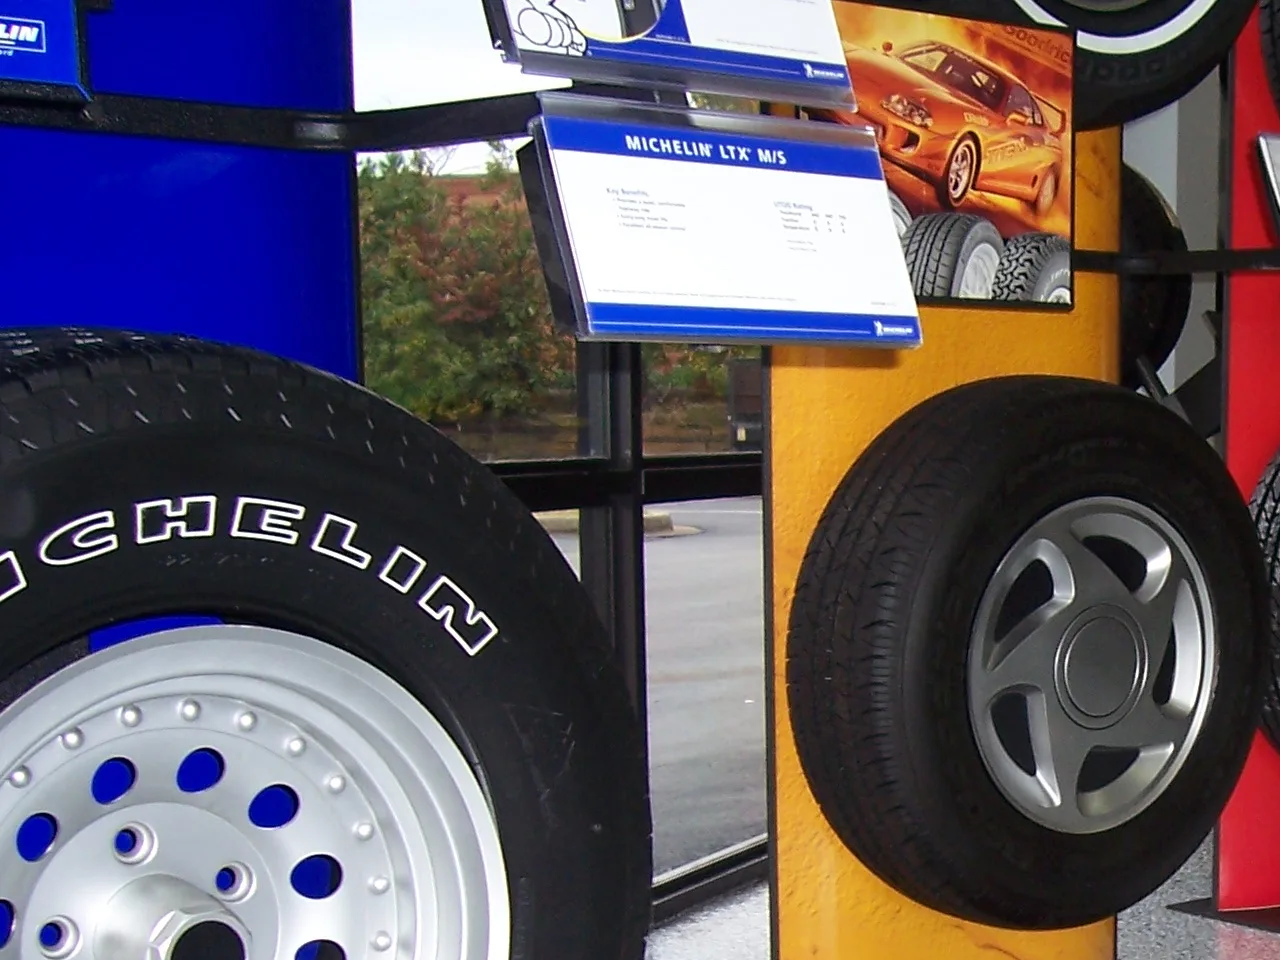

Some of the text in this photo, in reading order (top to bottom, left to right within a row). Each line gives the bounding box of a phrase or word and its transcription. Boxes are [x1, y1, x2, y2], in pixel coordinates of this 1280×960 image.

[625, 135, 787, 165] MICHELIN LTX M/S
[0, 494, 499, 657] ICHELIN
